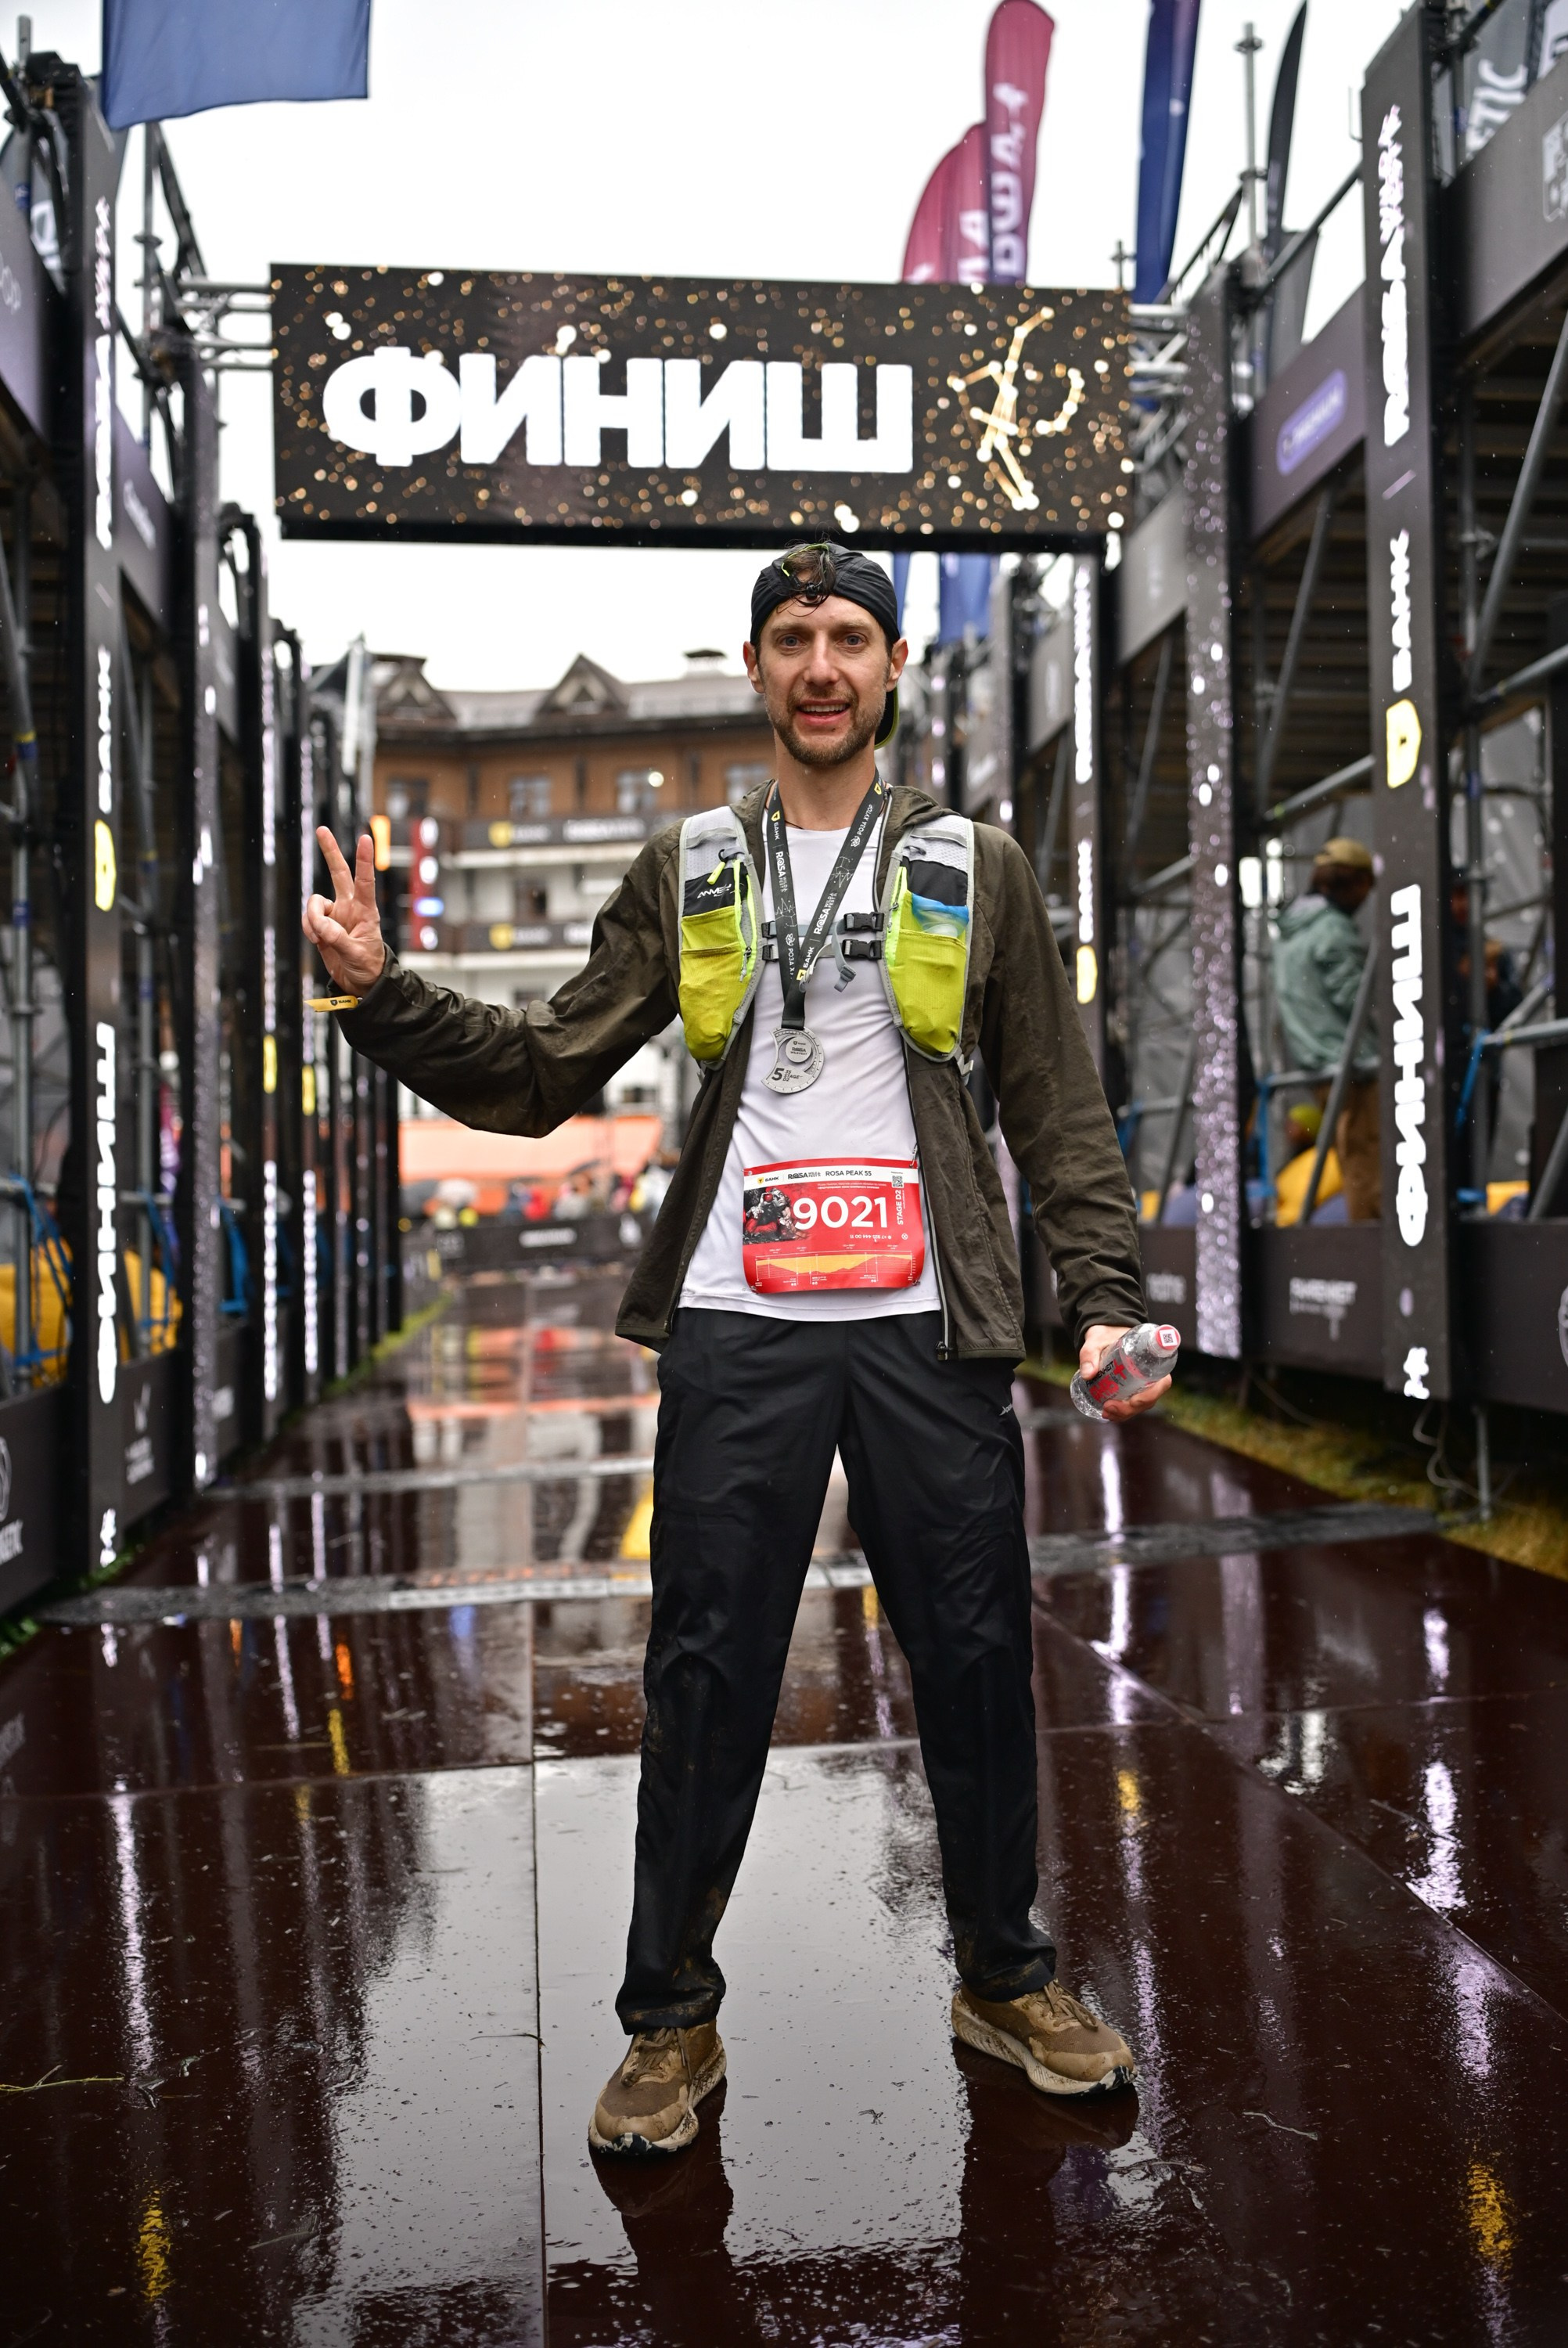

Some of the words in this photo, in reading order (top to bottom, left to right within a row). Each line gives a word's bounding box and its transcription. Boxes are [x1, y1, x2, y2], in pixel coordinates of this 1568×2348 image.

[322, 347, 913, 473] ФИНИШ
[857, 821, 867, 835] РОЗА
[863, 804, 873, 819] ХУТОР
[775, 851, 786, 877] ROSA
[813, 908, 831, 935] ROSA
[803, 946, 815, 968] БАНК
[771, 1068, 785, 1081] 5
[1390, 884, 1429, 1247] ФИНИШ
[894, 1189, 902, 1200] D2
[96, 1022, 117, 1403] ФИНИШ
[793, 1196, 888, 1230] 9021
